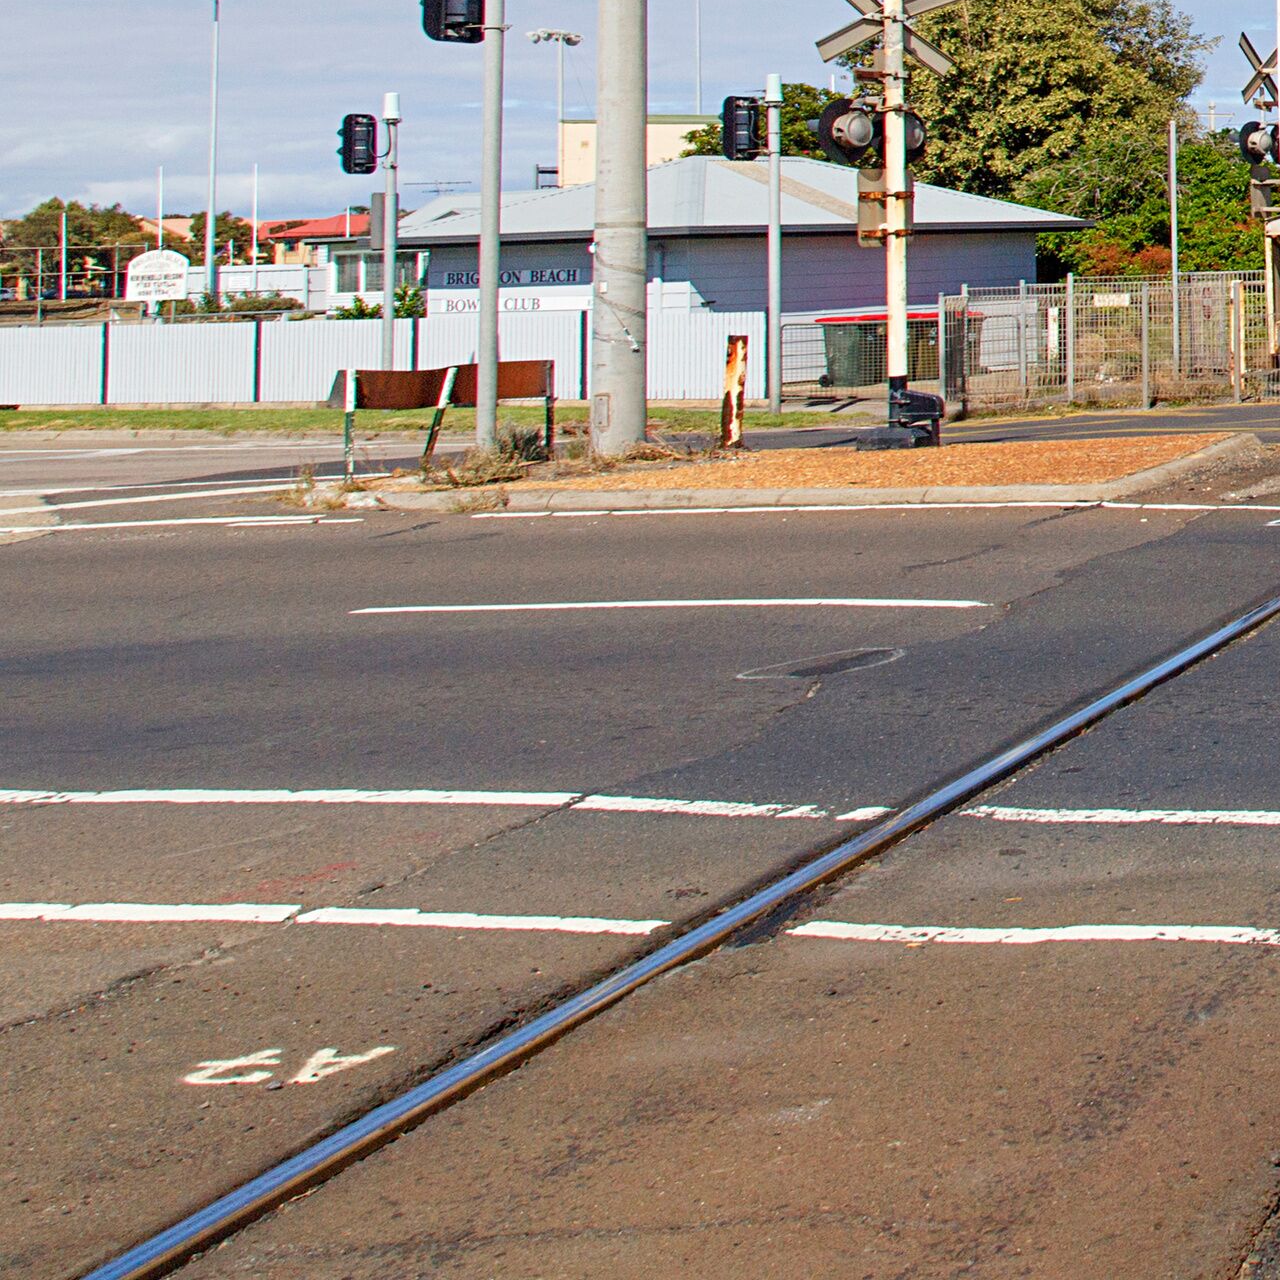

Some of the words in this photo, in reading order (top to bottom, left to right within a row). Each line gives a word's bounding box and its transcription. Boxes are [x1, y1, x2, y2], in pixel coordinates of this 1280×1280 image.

[447, 271, 521, 285] BRIGON
[530, 269, 577, 283] BEACH
[504, 298, 541, 311] CLUB
